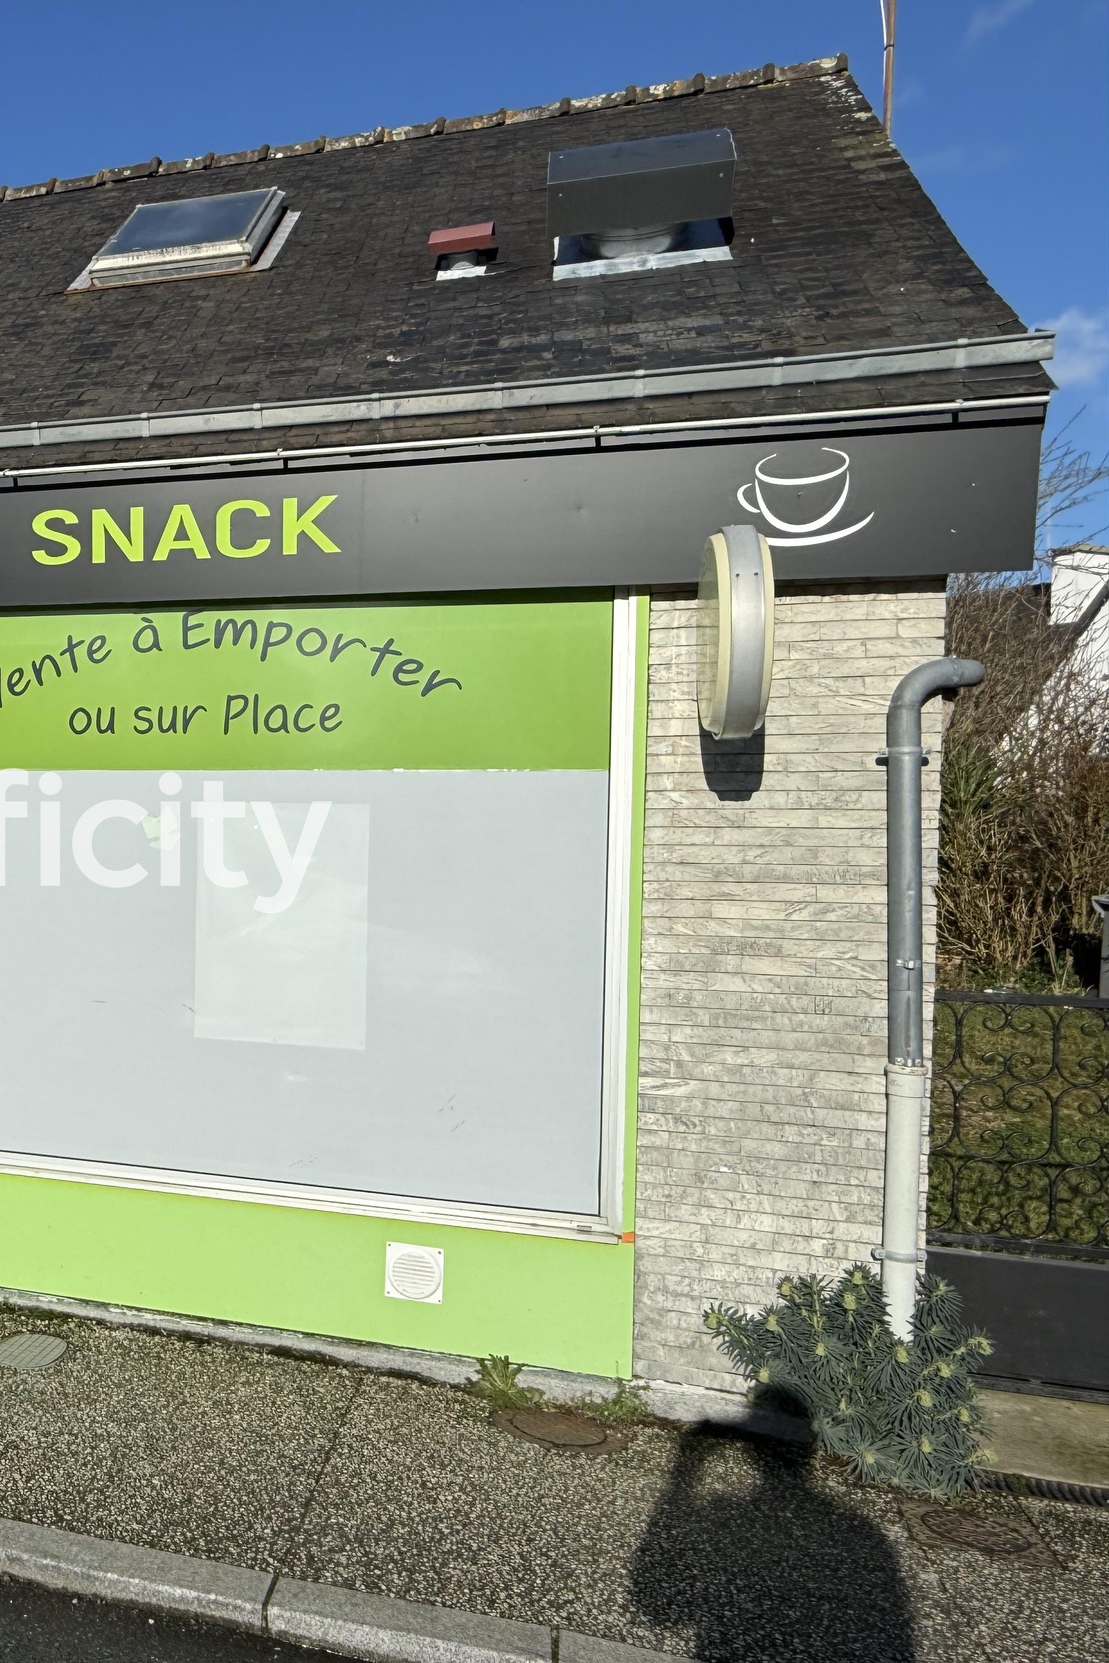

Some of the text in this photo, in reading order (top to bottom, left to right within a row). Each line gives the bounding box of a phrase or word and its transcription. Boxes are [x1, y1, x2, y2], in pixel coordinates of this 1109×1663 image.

[31, 494, 341, 566] SNACK
[132, 617, 162, 653] à
[182, 611, 462, 697] Emporter
[68, 693, 343, 735] ou sur Place
